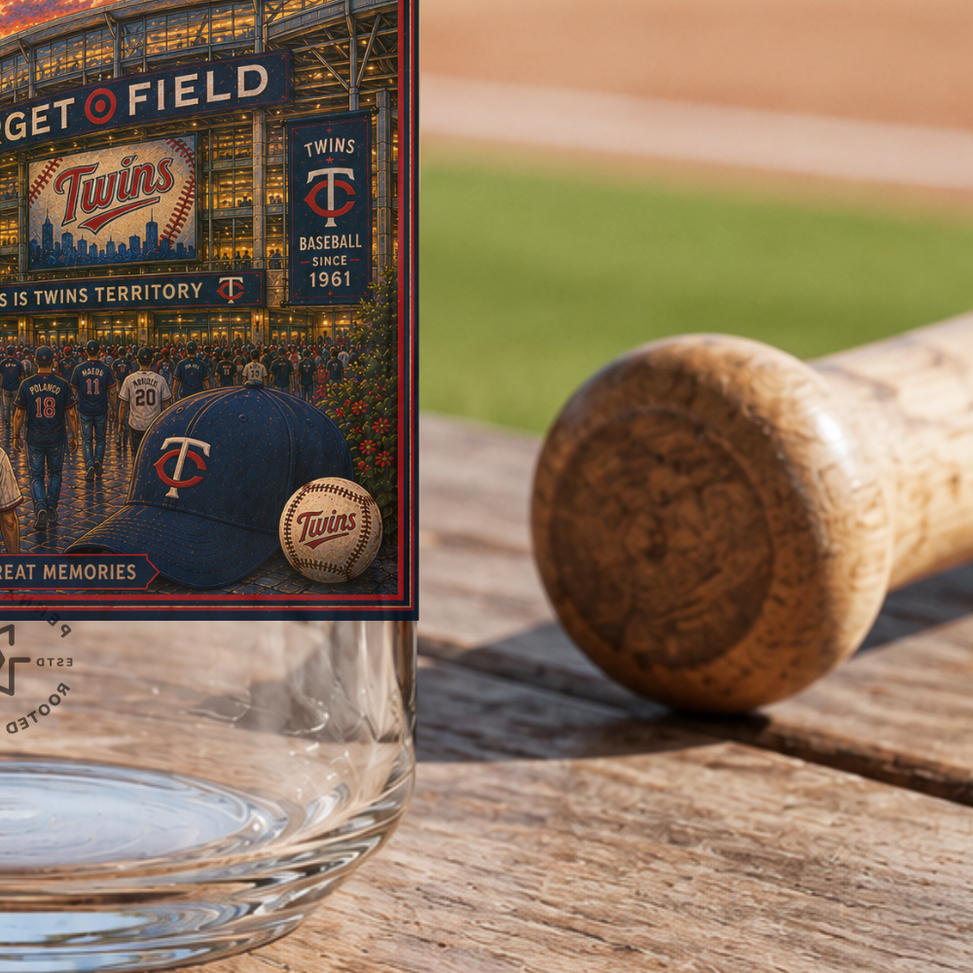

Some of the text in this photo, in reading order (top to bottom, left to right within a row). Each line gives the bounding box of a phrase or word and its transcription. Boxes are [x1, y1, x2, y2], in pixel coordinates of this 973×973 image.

[129, 64, 269, 117] FIELD
[304, 138, 356, 158] TWINS
[53, 155, 175, 228] Twins
[299, 232, 363, 252] BASEBALL
[312, 255, 348, 268] SINCE
[309, 271, 352, 288] 1961
[13, 292, 28, 308] IS
[33, 287, 88, 306] TWINS
[94, 283, 202, 303] TERRITORY
[85, 378, 101, 396] 11
[34, 396, 56, 419] 18
[135, 388, 157, 407] 20
[296, 509, 357, 543] Twins
[43, 564, 137, 580] MEMORIES
